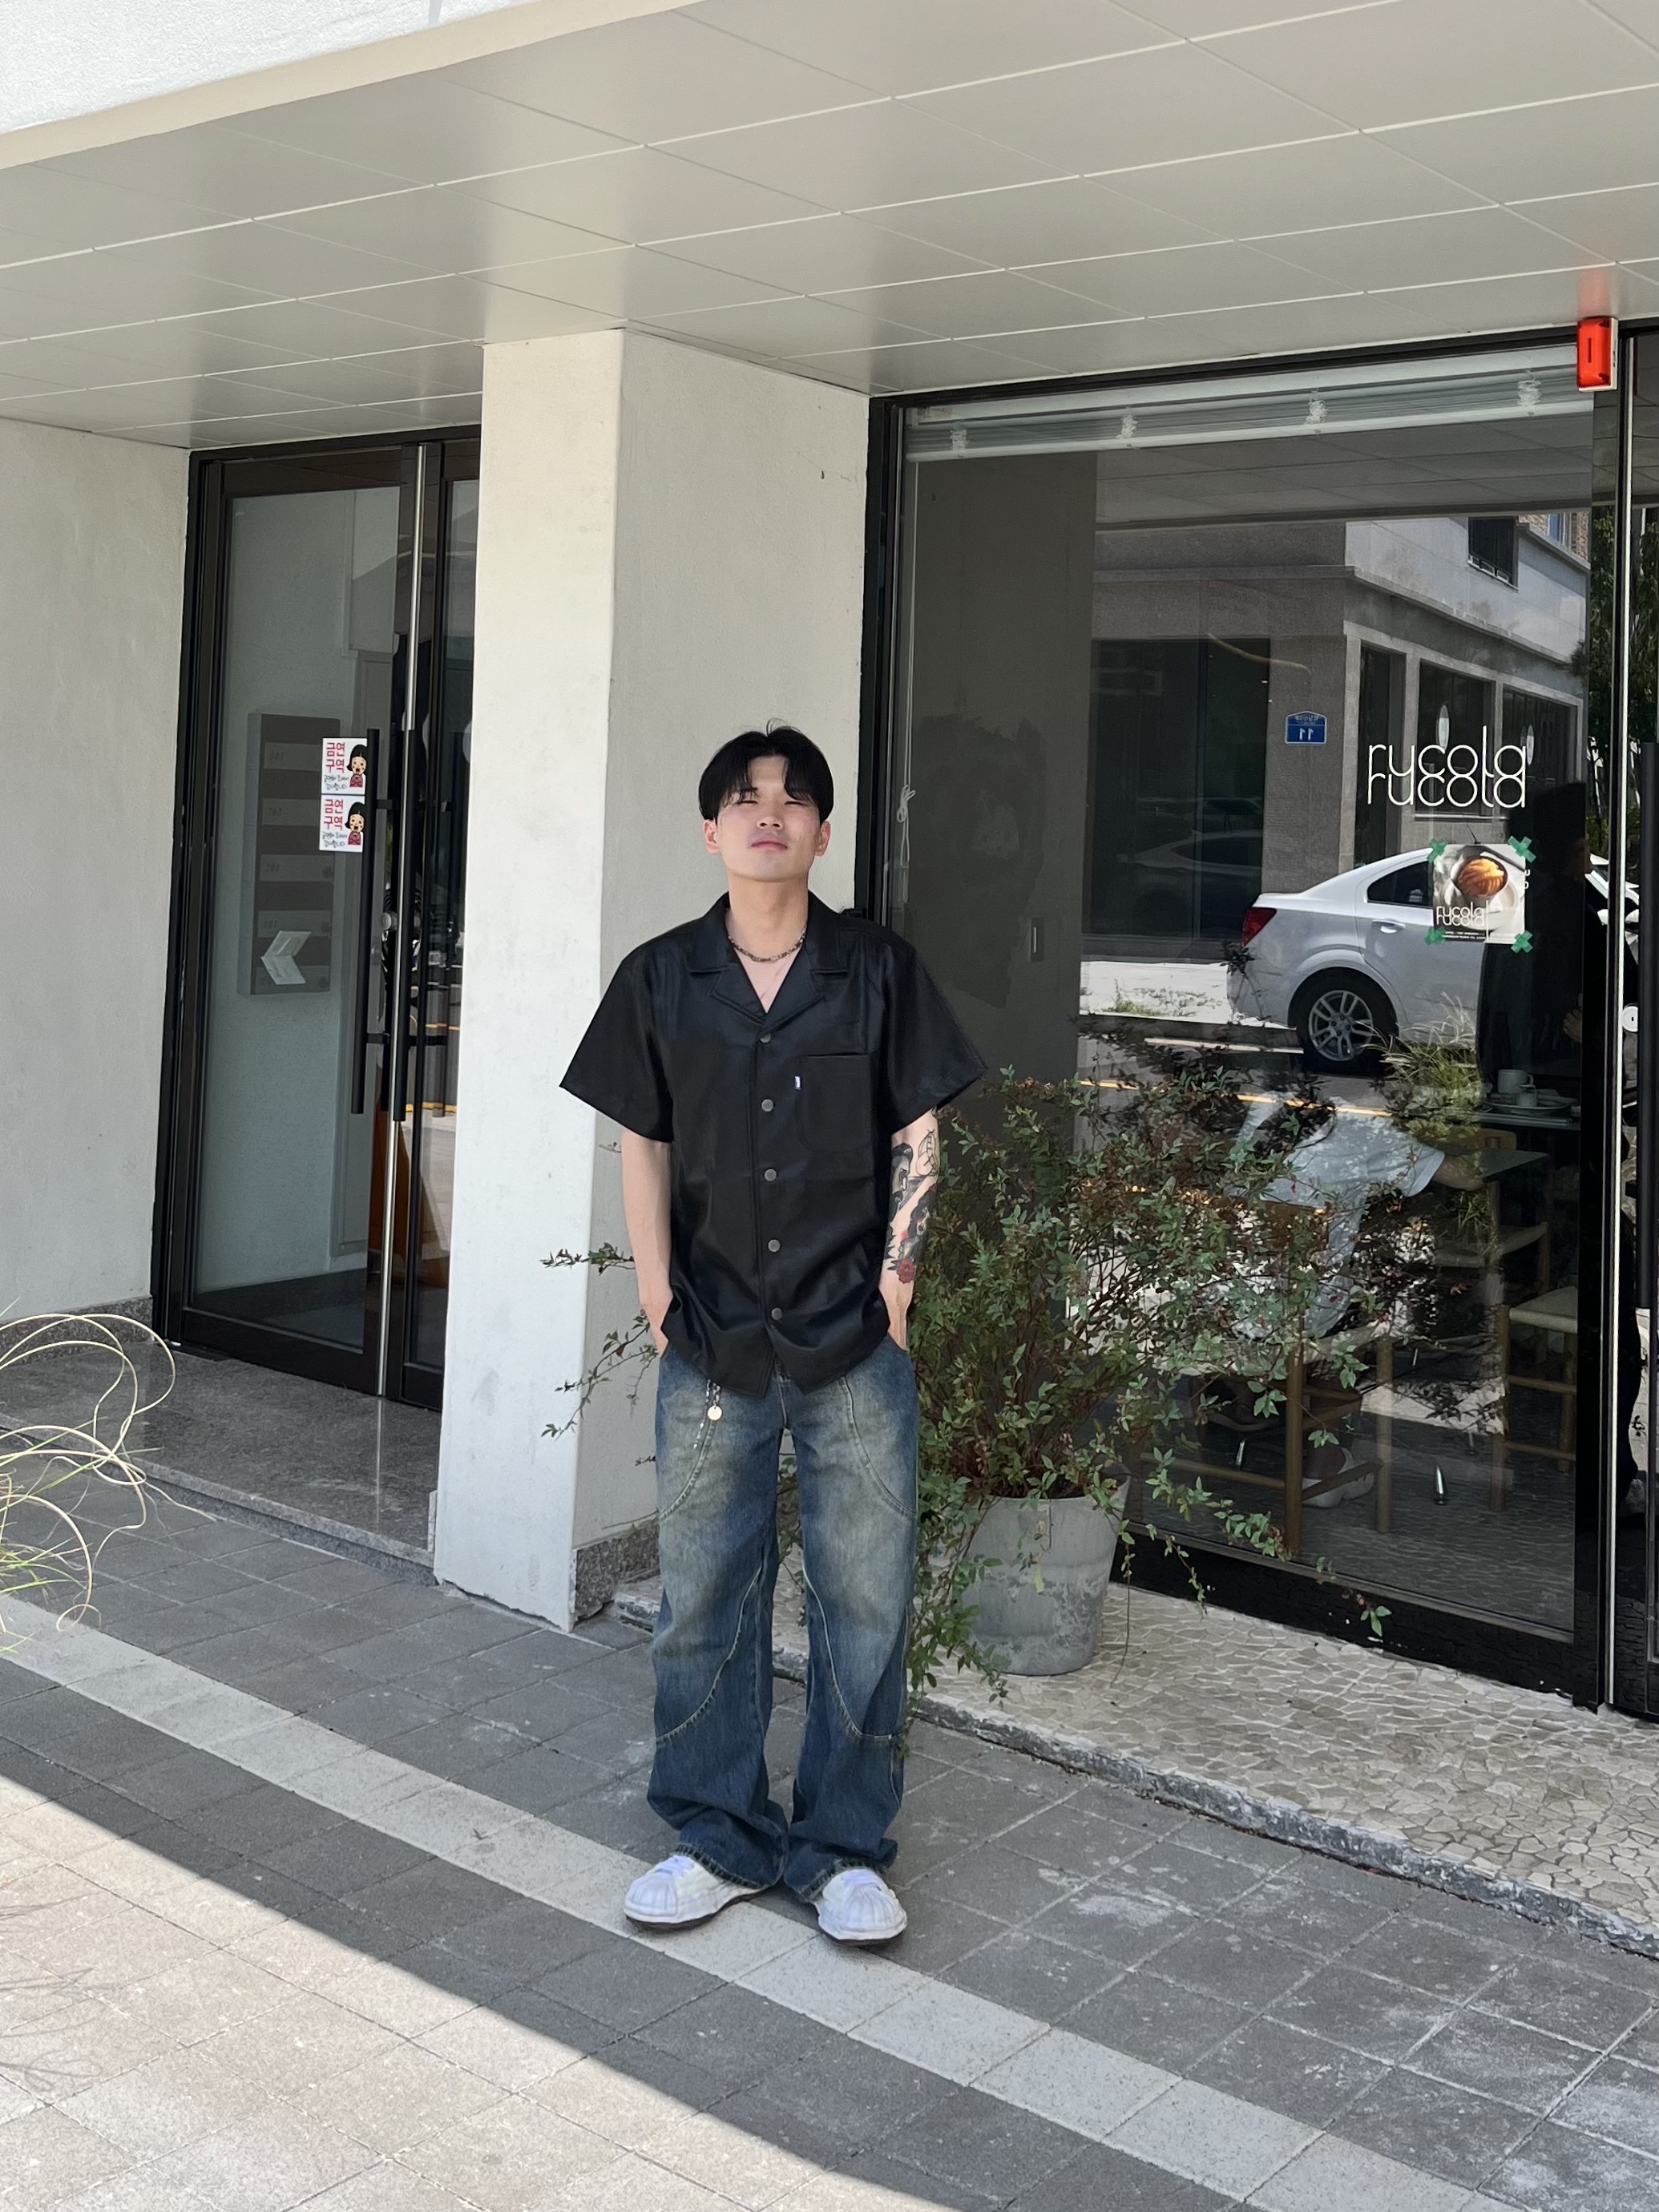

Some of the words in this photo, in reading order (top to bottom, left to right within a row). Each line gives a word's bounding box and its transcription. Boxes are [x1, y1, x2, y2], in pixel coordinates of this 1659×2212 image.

[325, 742, 345, 757] 금연
[325, 759, 345, 773] 구역
[324, 799, 344, 814] 금연
[323, 816, 343, 831] 구역
